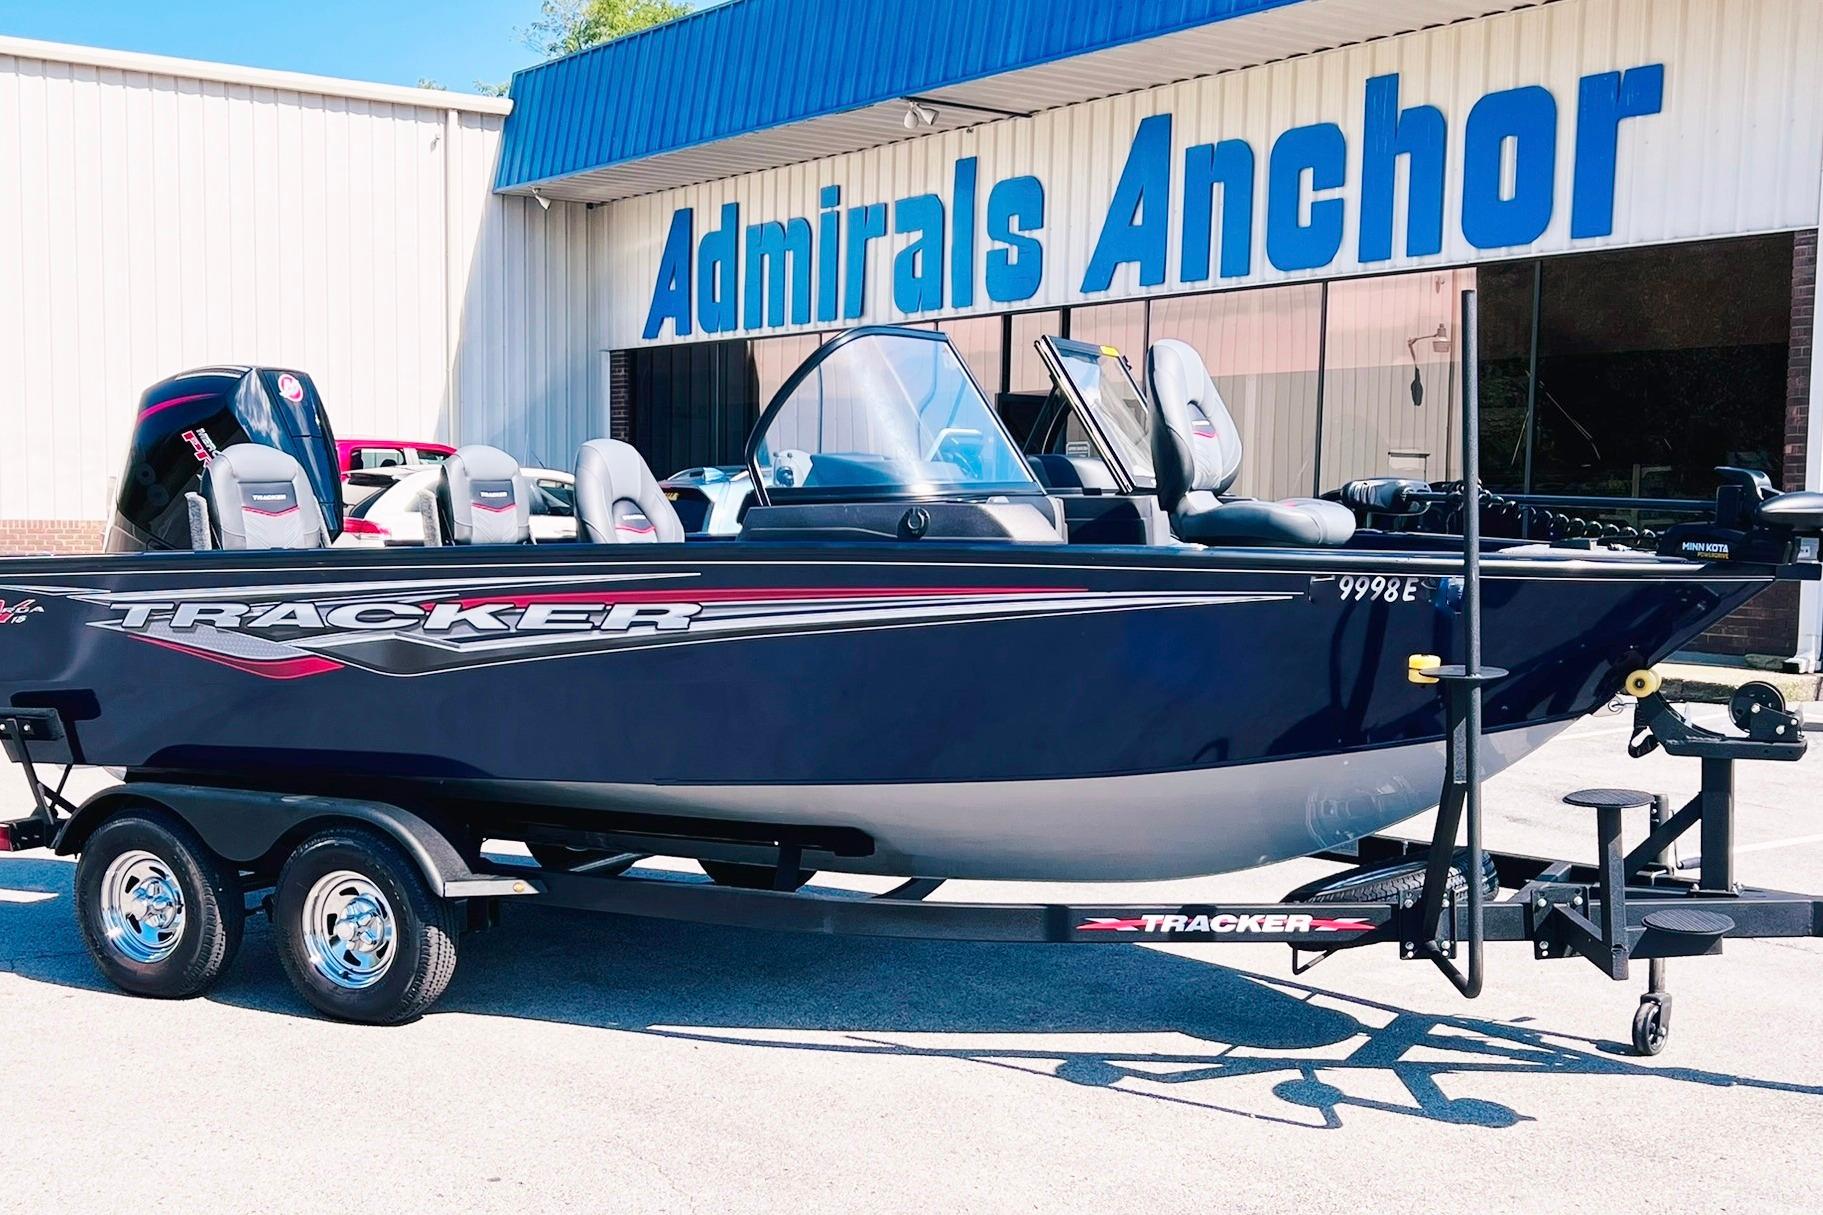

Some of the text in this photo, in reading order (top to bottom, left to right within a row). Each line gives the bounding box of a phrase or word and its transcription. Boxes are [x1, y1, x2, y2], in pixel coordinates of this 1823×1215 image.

[643, 65, 1662, 341] Admirals Anchor
[1682, 541, 1729, 553] MINN KOTA
[1338, 575, 1420, 603] 9998 E
[109, 601, 702, 632] TRACKER
[1140, 914, 1313, 933] TRACKER
